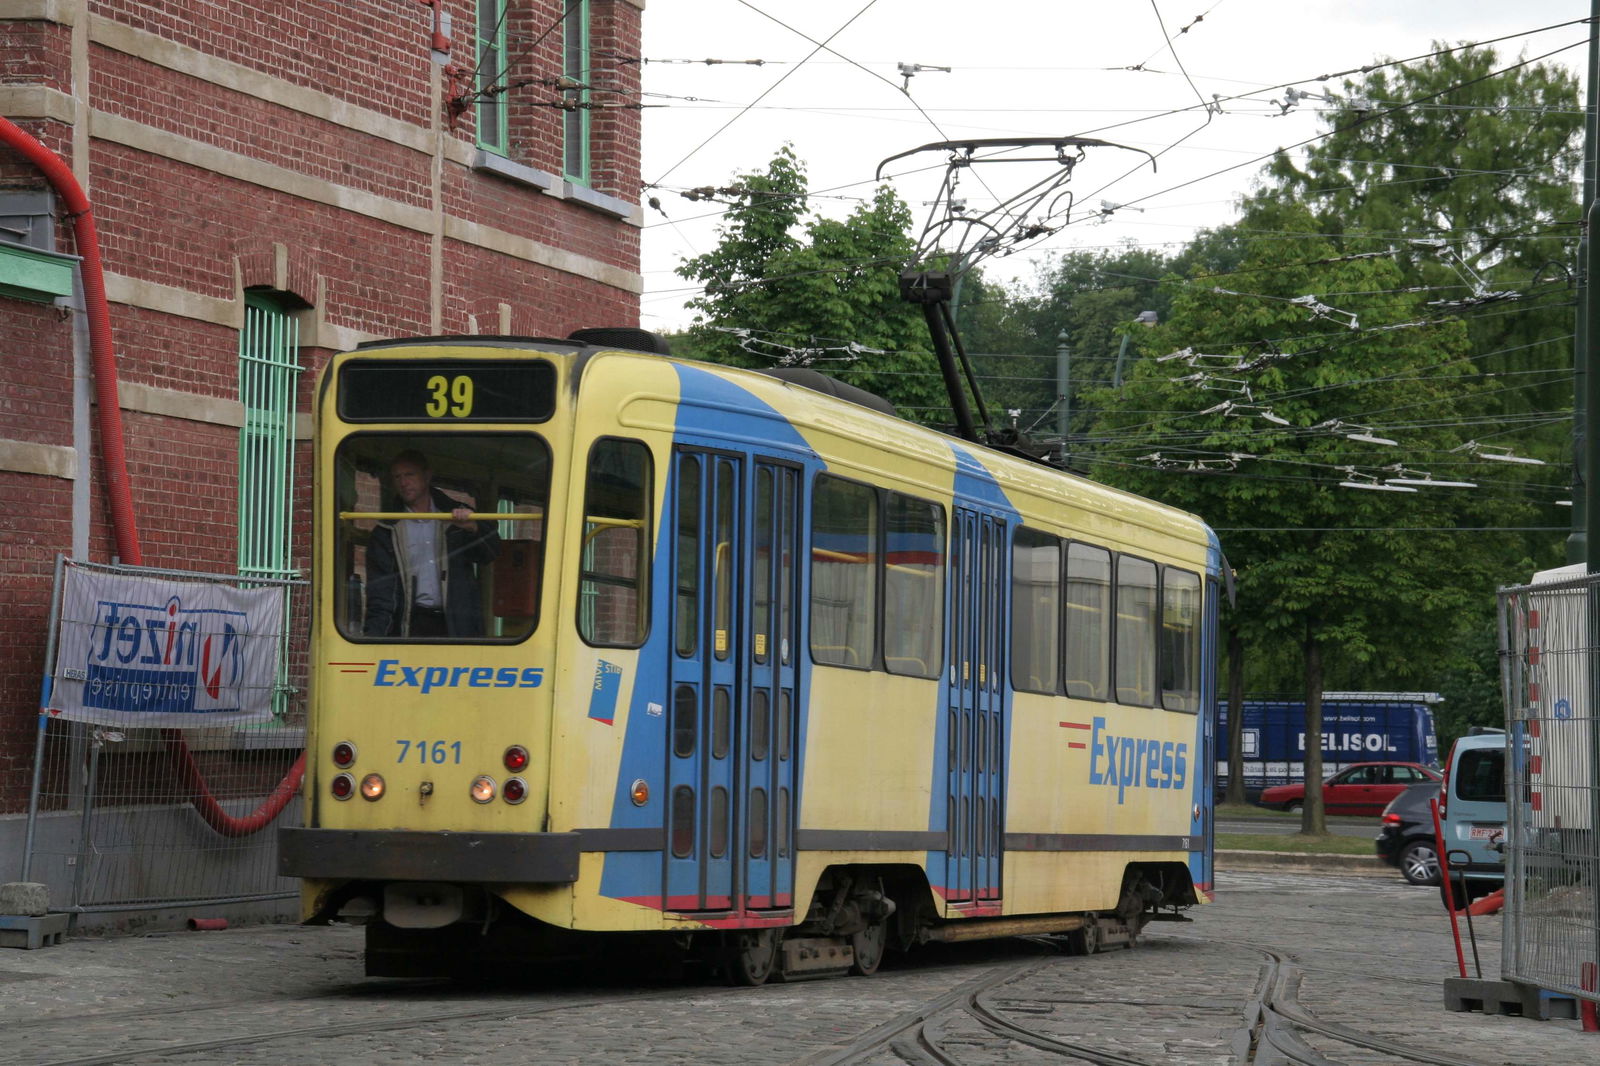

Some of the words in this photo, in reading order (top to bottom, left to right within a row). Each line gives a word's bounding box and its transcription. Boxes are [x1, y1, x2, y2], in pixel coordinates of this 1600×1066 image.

[426, 375, 473, 418] 39
[66, 669, 86, 680] HERAS
[373, 659, 545, 694] Express
[605, 663, 623, 674] STIB
[1323, 714, 1376, 722] www.belisolcom
[396, 740, 461, 764] 7161
[1089, 716, 1187, 805] Express
